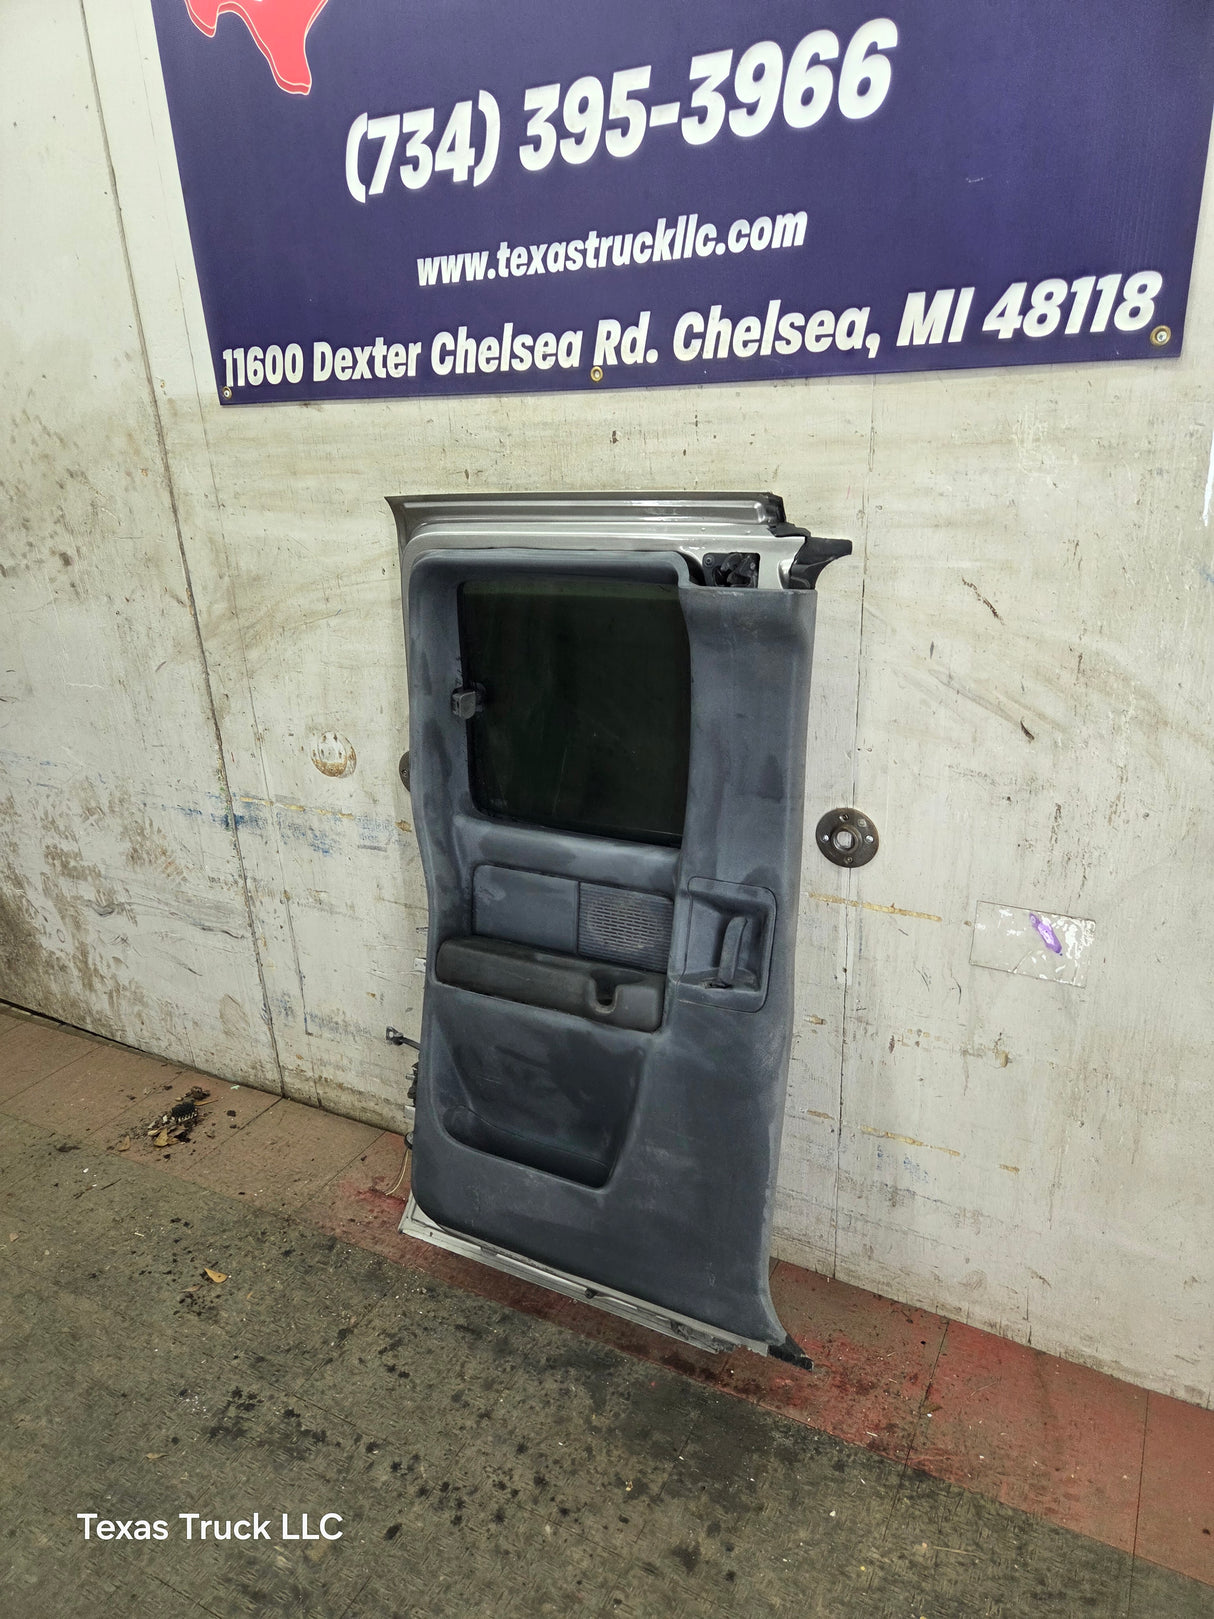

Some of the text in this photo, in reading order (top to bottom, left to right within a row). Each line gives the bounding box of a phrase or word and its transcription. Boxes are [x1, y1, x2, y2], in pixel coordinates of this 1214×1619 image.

[346, 18, 898, 203] (734) 395-3966
[417, 212, 807, 286] www.texastruckllc.com
[223, 271, 1163, 387] 11600 Dexter Chelsea Rd. Chelsea, MI 48118
